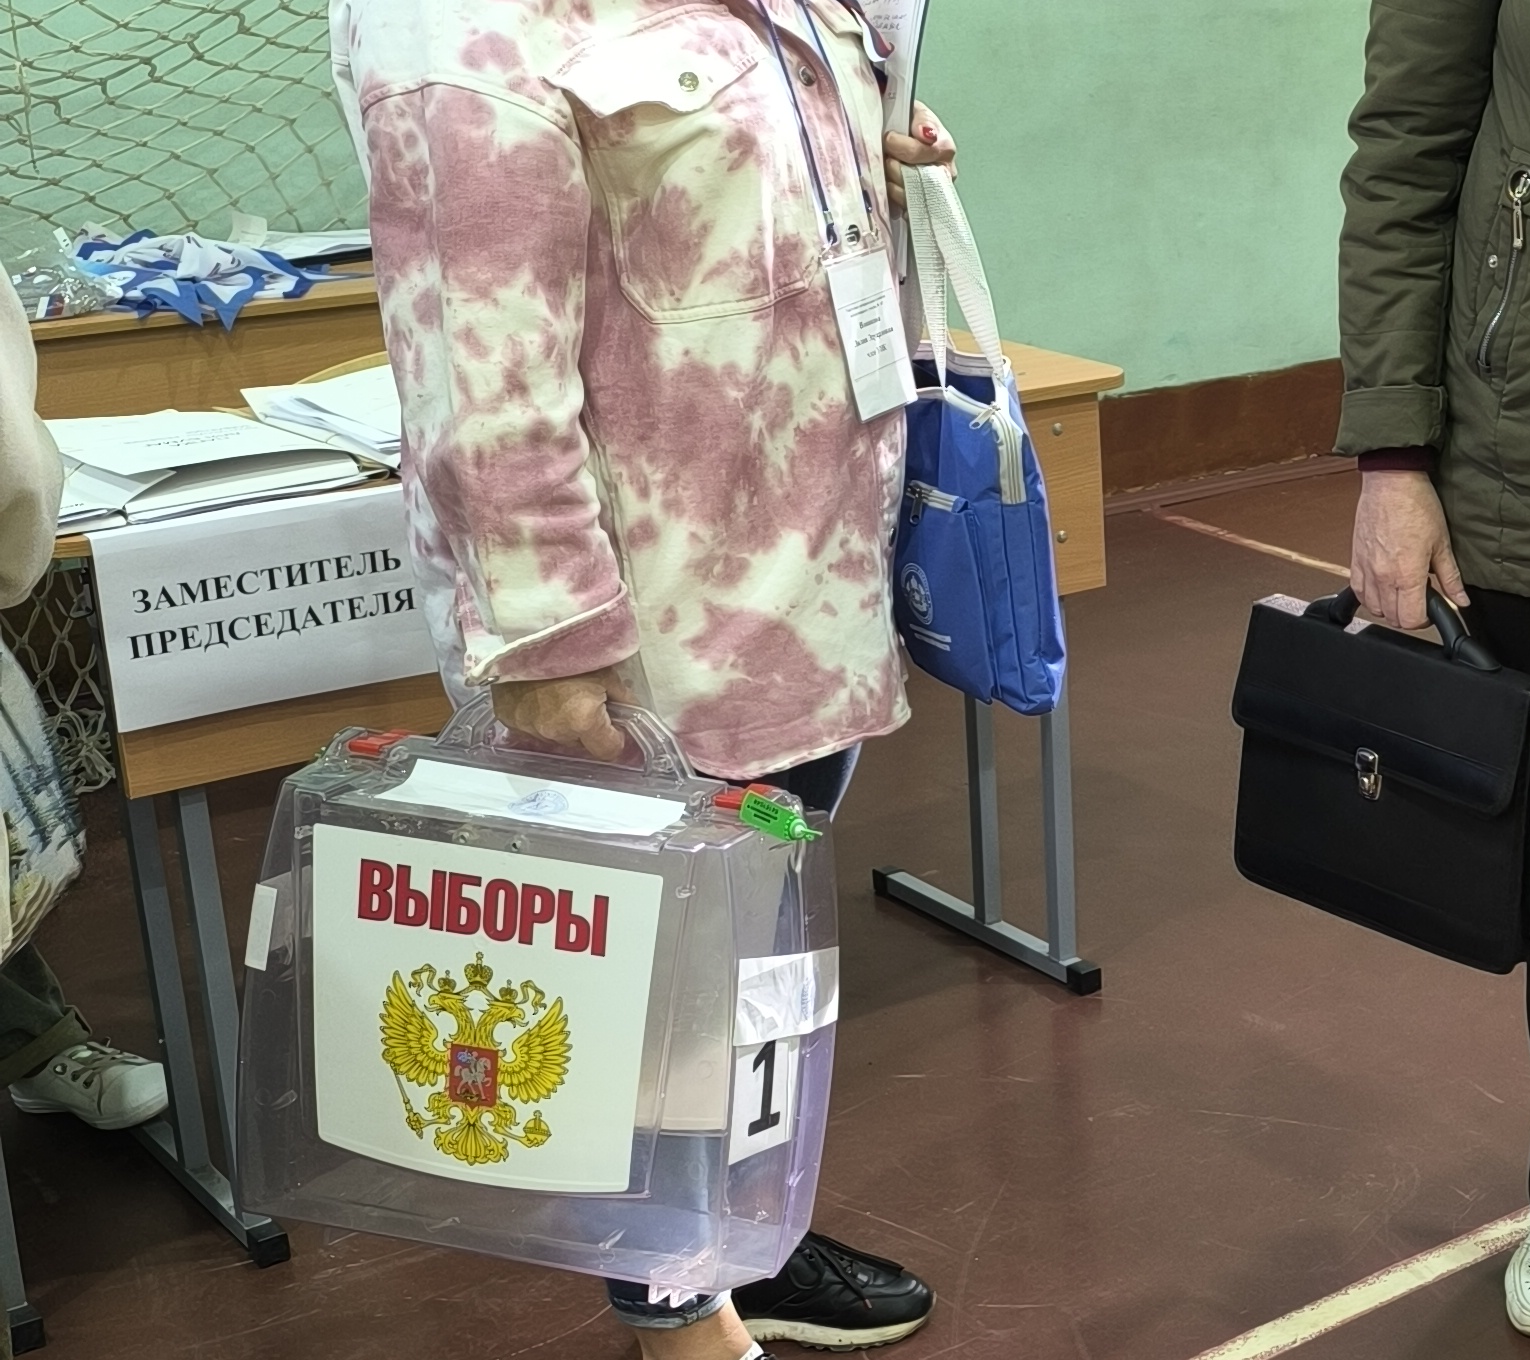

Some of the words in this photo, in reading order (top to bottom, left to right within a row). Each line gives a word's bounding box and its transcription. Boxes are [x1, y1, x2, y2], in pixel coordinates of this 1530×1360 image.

[132, 548, 401, 613] ЗАМЕСТИТЕЛЬ
[128, 587, 417, 660] ПРЕДСЕДАТЕЛЯ
[357, 857, 611, 958] ВЫБОРЫ
[747, 1041, 782, 1137] 1
